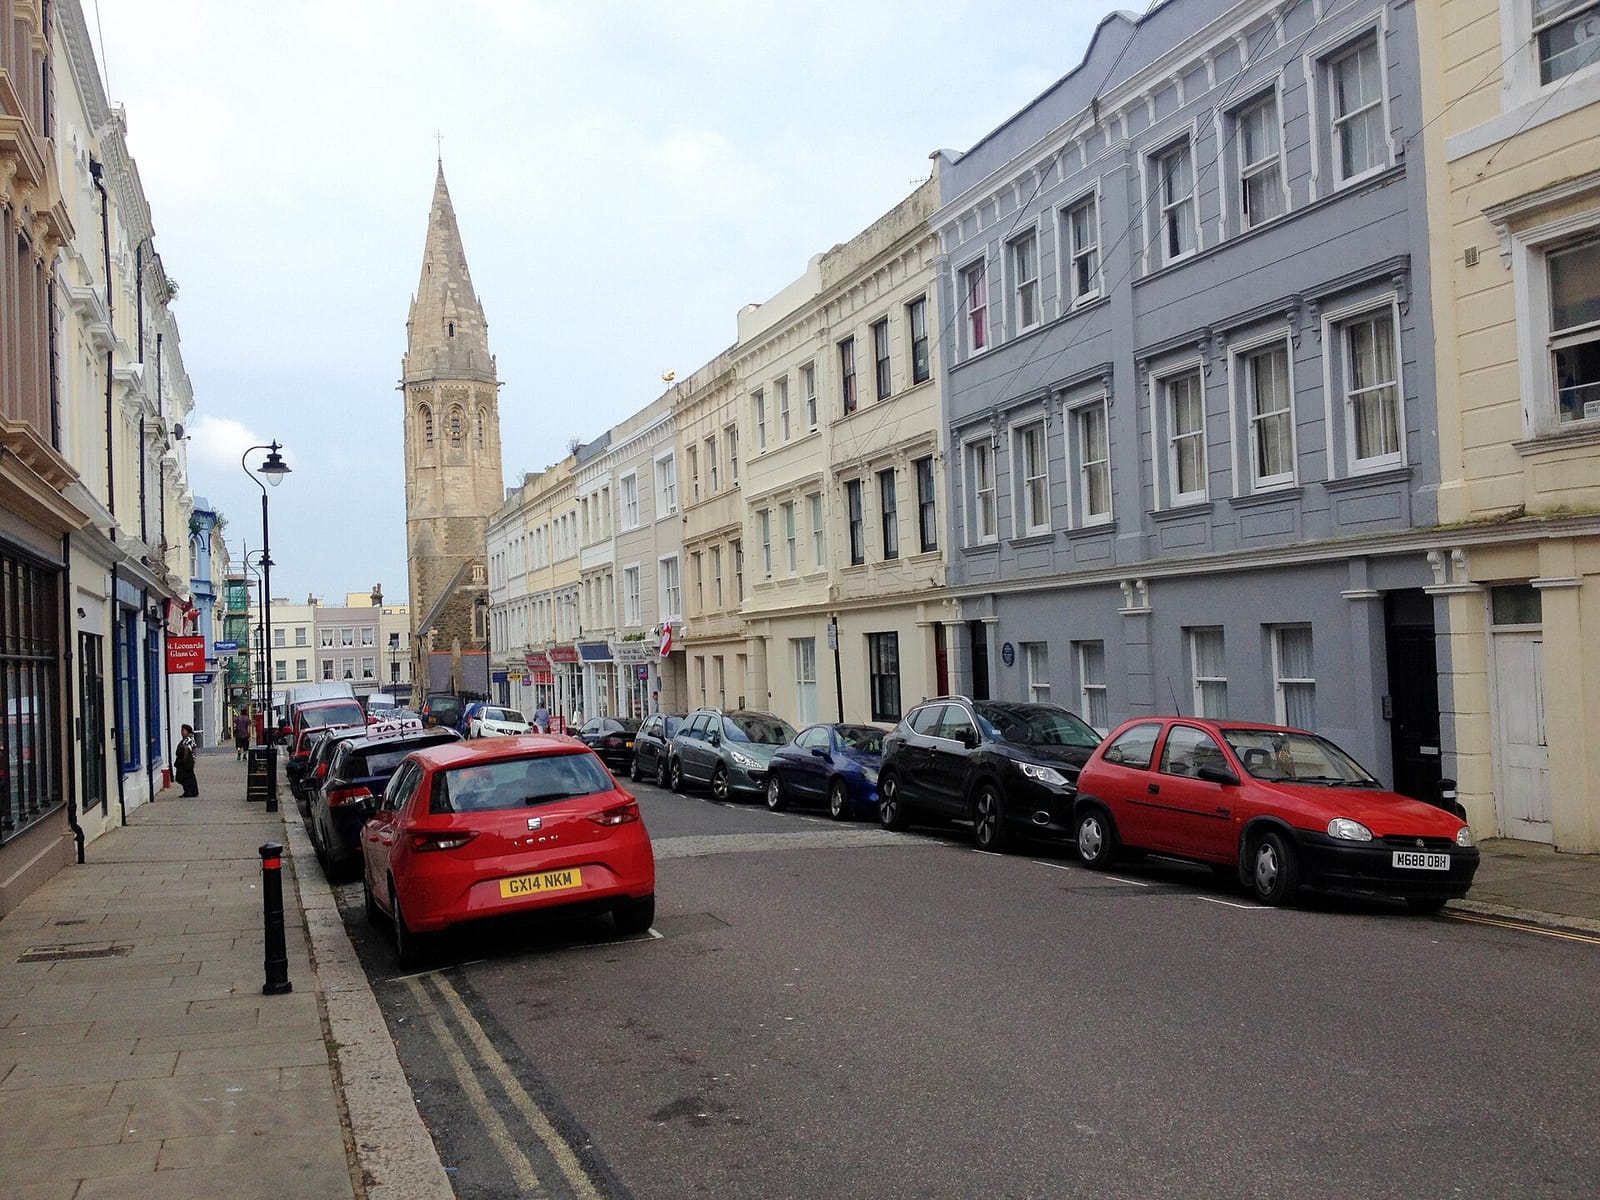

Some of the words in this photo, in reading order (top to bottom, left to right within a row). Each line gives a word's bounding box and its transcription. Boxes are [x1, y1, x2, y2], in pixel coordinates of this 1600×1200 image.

[372, 721, 417, 733] TAXI
[509, 876, 541, 893] GX14
[544, 872, 572, 888] NKM
